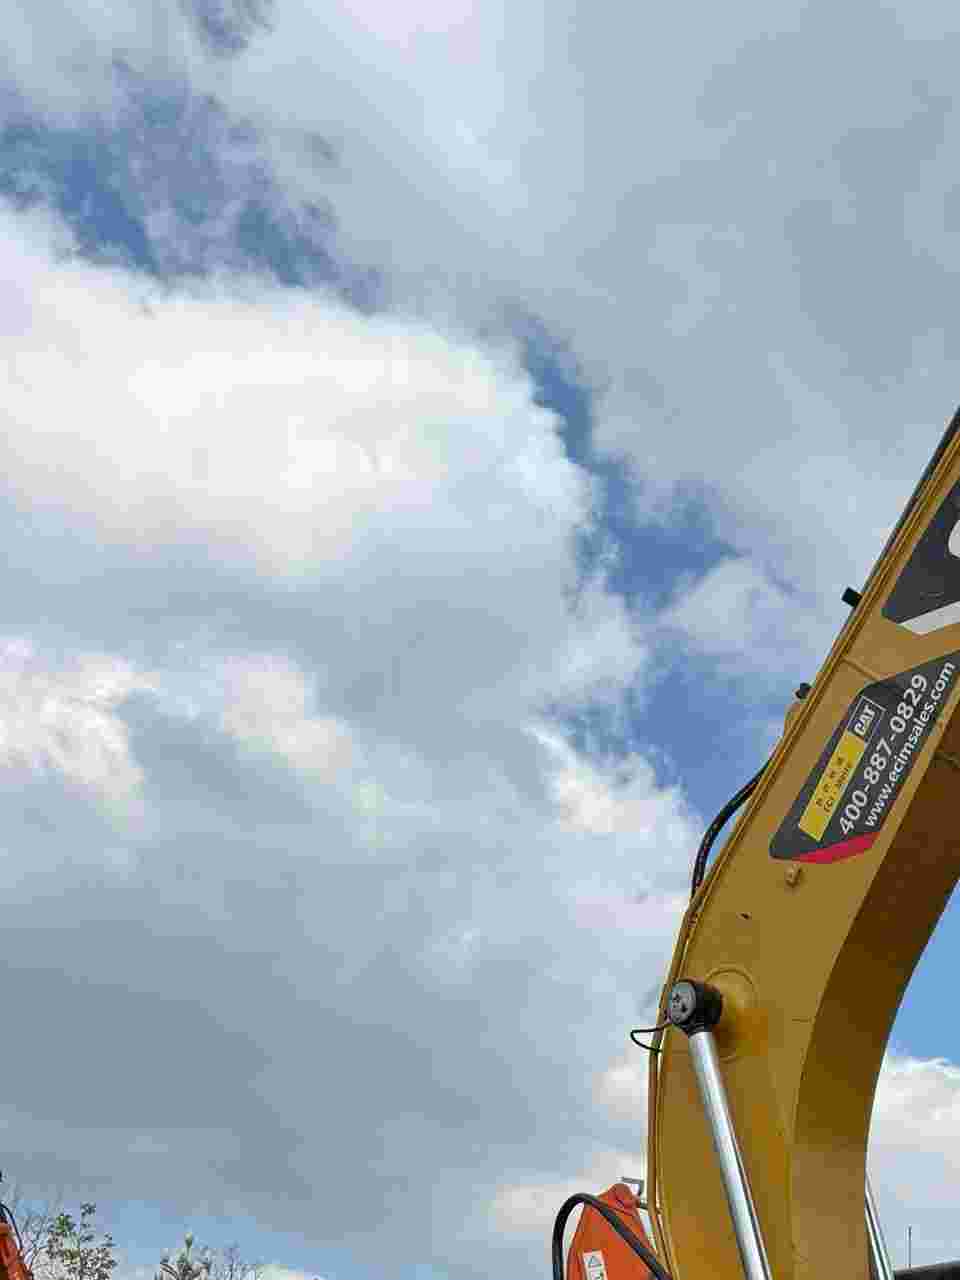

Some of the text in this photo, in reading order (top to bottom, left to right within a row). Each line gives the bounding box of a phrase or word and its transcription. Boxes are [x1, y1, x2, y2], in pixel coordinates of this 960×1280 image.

[840, 674, 928, 835] 400-887-0829
[853, 704, 876, 736] CAT
[865, 661, 956, 827] www.ecimsales.com
